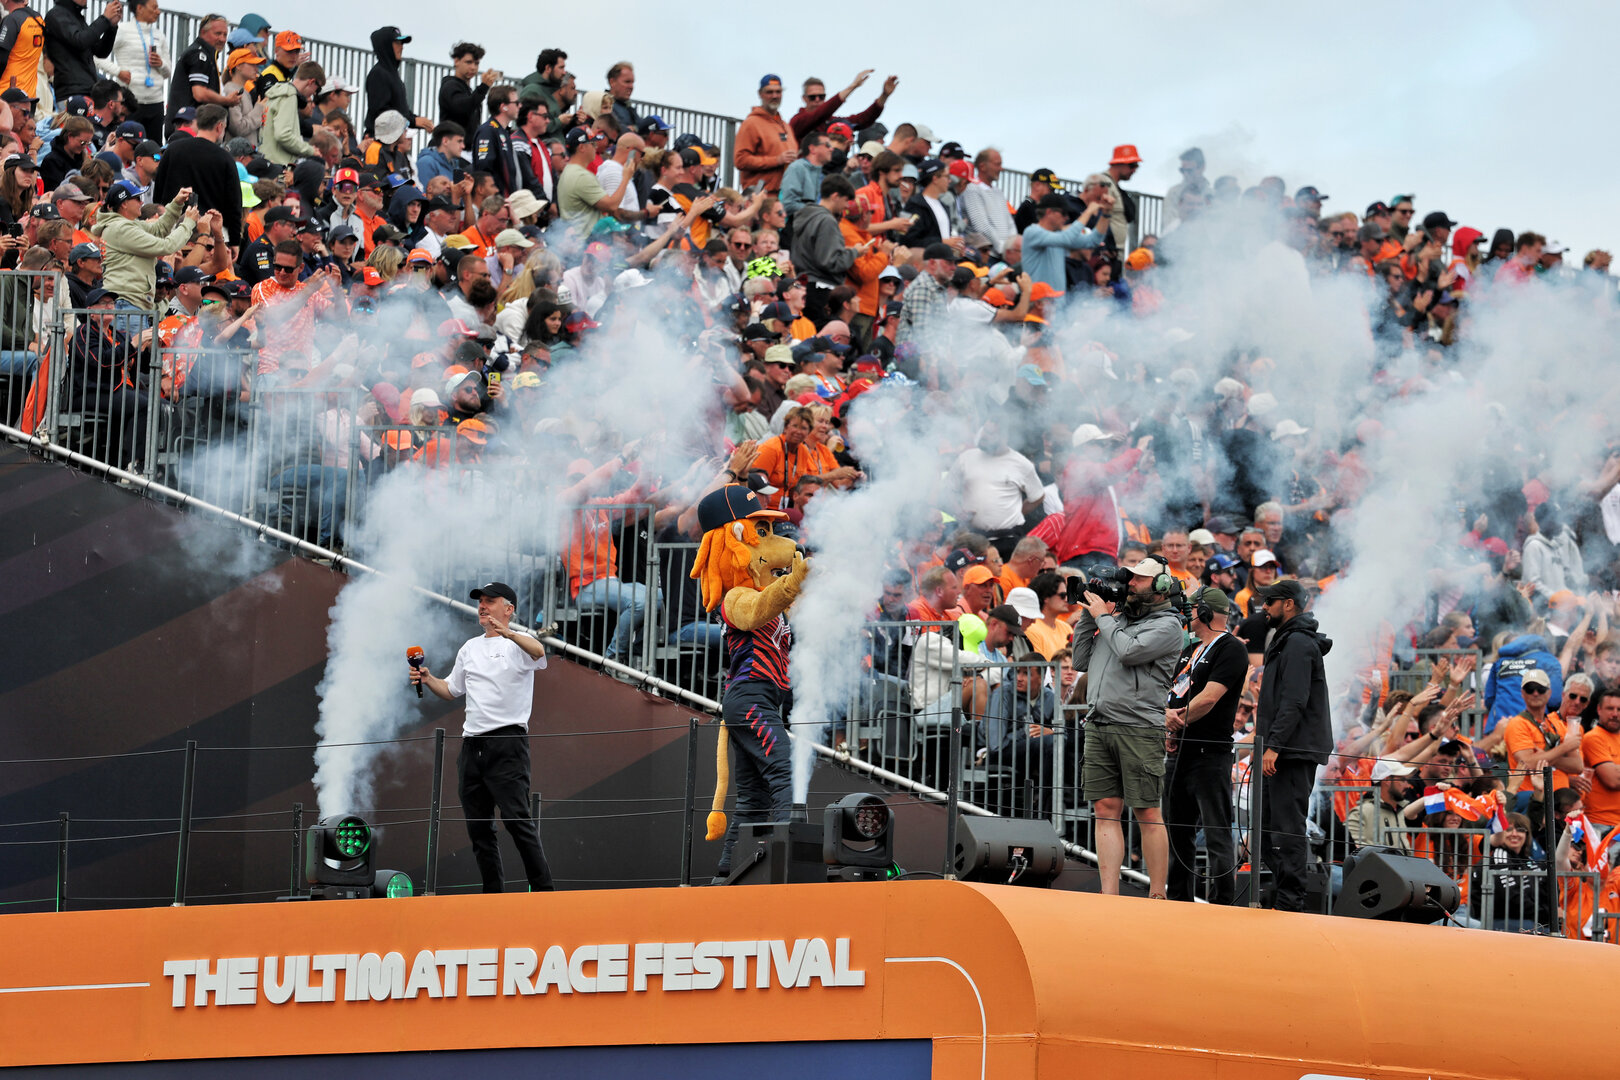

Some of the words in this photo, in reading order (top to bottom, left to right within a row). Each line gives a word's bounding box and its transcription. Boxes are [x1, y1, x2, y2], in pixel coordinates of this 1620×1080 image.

[163, 957, 259, 1007] THE
[263, 948, 499, 1004] ULTIMATE
[503, 943, 629, 996] RACE
[633, 937, 866, 991] FESTIVAL
